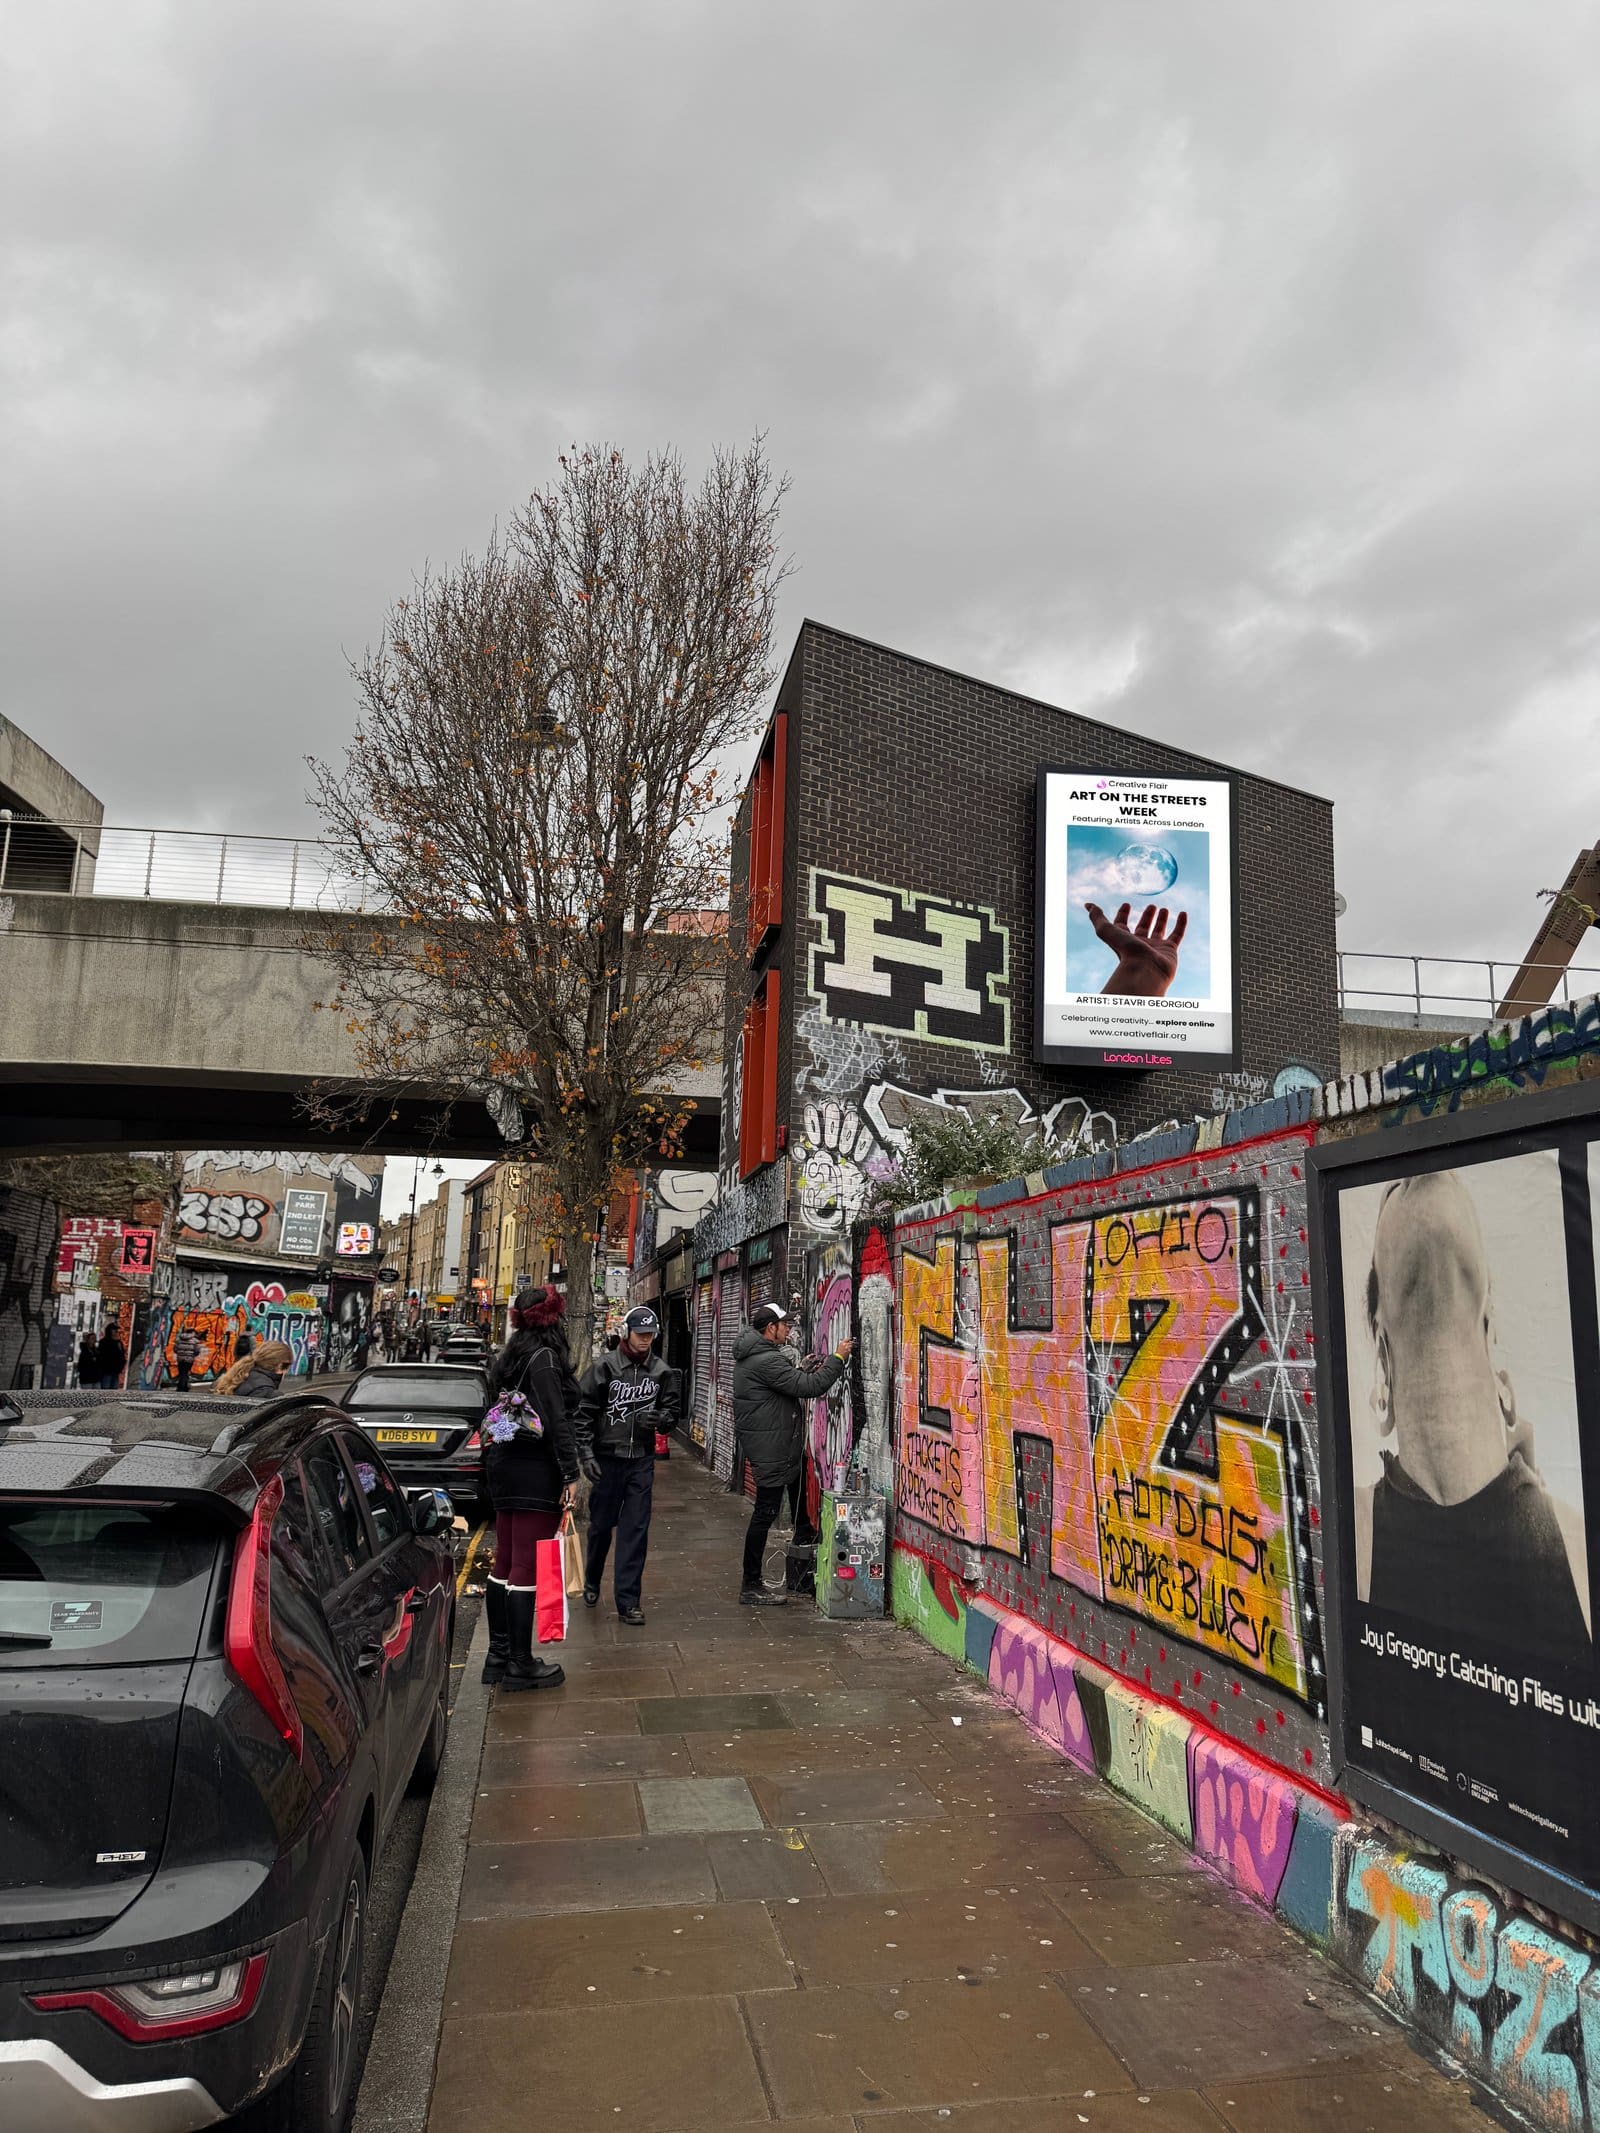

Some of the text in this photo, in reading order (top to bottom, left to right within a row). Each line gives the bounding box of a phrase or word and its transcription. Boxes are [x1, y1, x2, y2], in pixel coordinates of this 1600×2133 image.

[1108, 780, 1168, 790] Creative Flair
[1069, 791, 1207, 806] ART ON THE STREETS
[1119, 806, 1158, 818] WEEK
[1072, 815, 1204, 828] Featuring Artists Across London
[1076, 996, 1200, 1009] ARTIST: STAVRI GEORGIOU
[1061, 1014, 1110, 1024] Celebrating
[1156, 1018, 1187, 1028] explore
[1089, 1028, 1187, 1041] www.creativeflair.org
[1104, 1052, 1172, 1064] London Lites
[382, 1431, 432, 1440] WD68 SYV
[907, 1432, 962, 1497] JACKETS
[1360, 1624, 1384, 1656] Joy
[1386, 1632, 1446, 1678] Gregory:
[1450, 1652, 1518, 1706] Catching
[1523, 1677, 1564, 1716] Flies
[102, 1853, 142, 1861] PHEV
